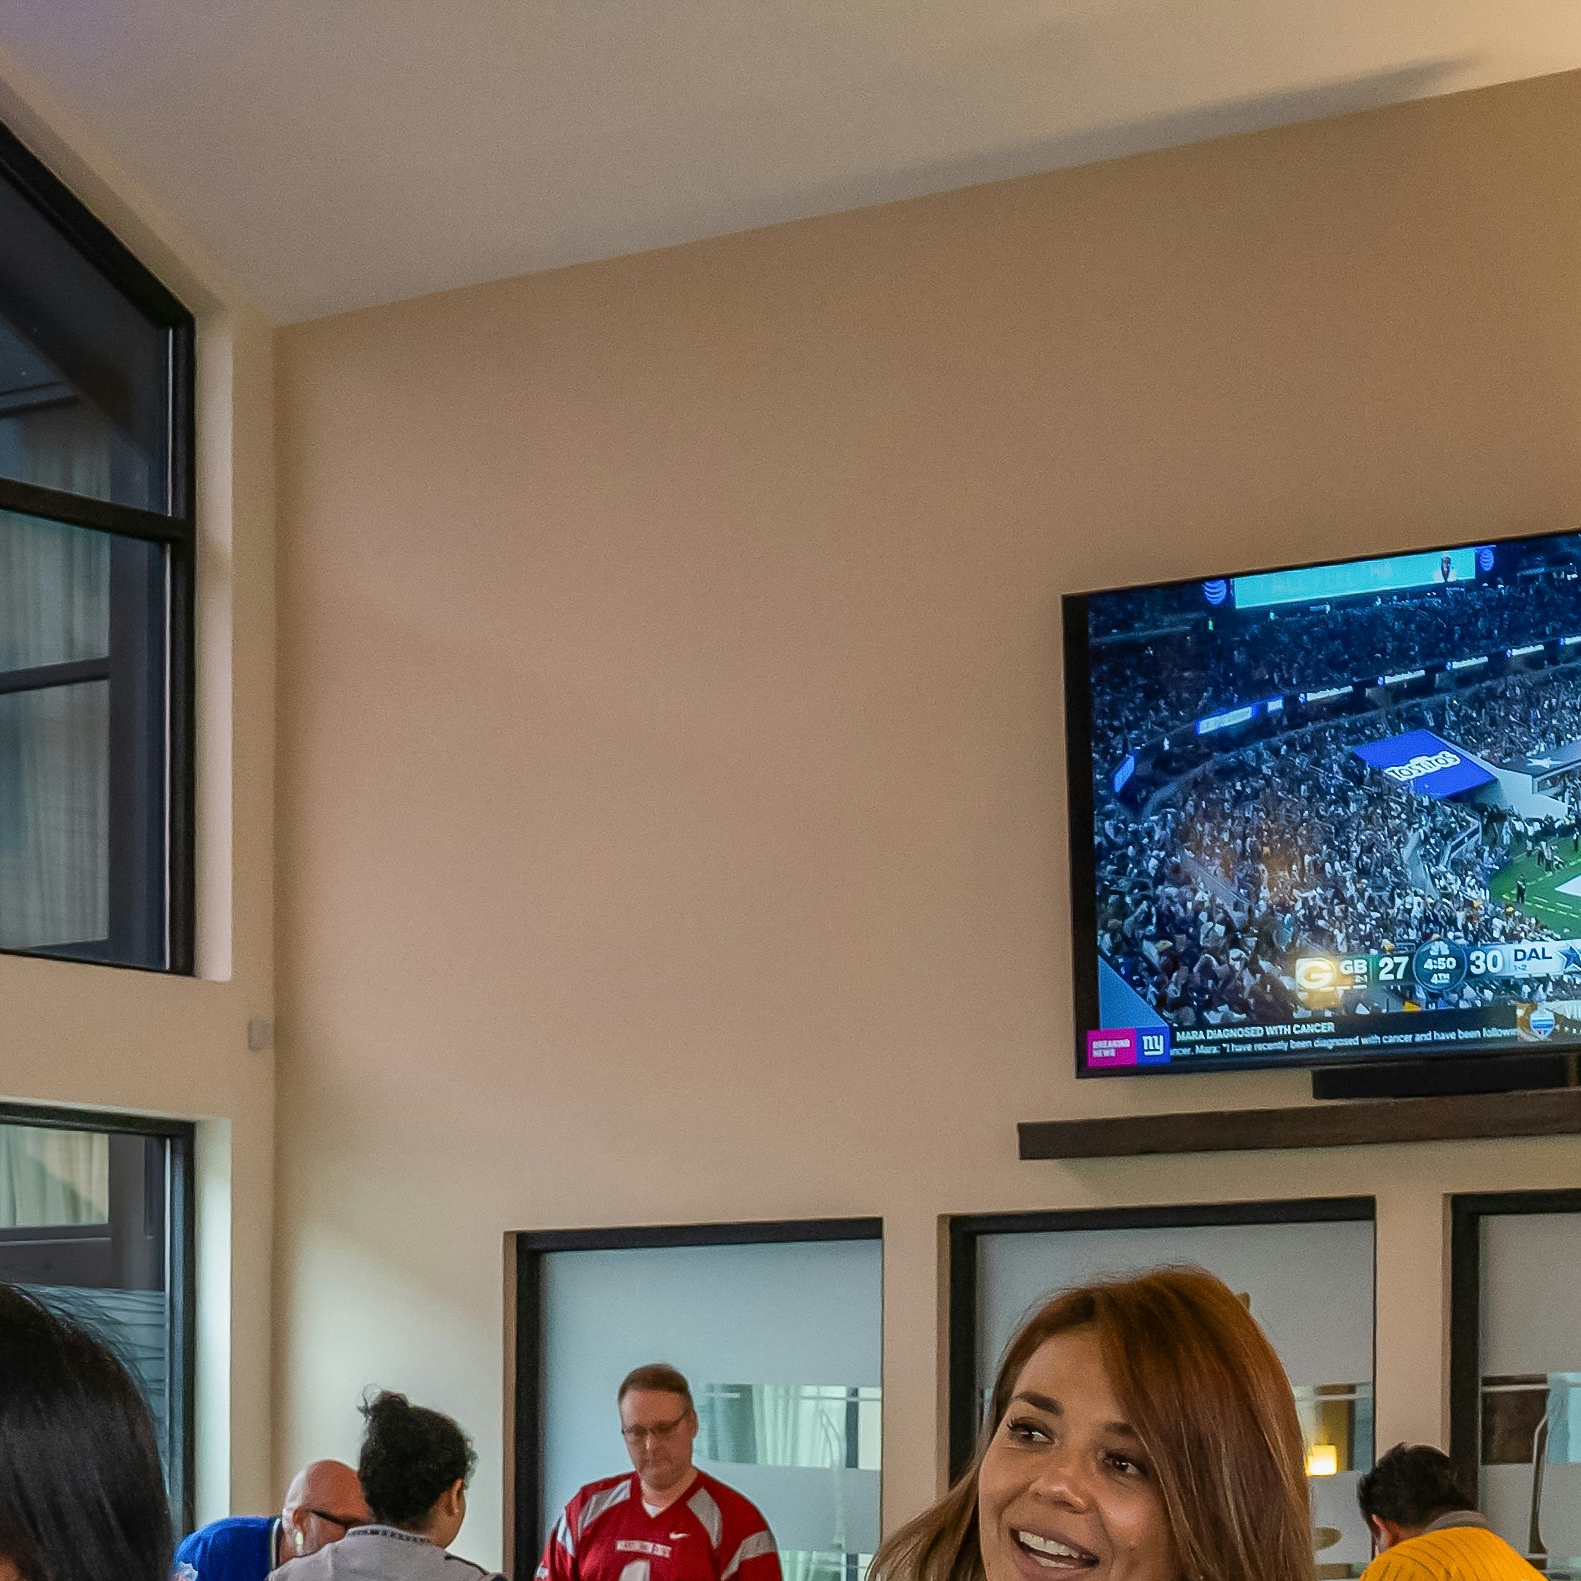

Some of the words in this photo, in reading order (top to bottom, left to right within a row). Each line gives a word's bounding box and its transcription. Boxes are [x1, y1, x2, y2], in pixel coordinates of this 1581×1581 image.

[1339, 959, 1368, 974] GB
[1378, 955, 1410, 981] 27
[1423, 956, 1457, 970] 4:50
[1469, 949, 1504, 975] 30
[1513, 946, 1553, 962] DAL
[1176, 1030, 1205, 1043] MARA
[1206, 1026, 1264, 1040] DIAGNOSED
[1265, 1024, 1291, 1037] WITH
[1292, 1021, 1336, 1035] CANCER
[1414, 1031, 1432, 1042] and
[1433, 1030, 1457, 1041] have
